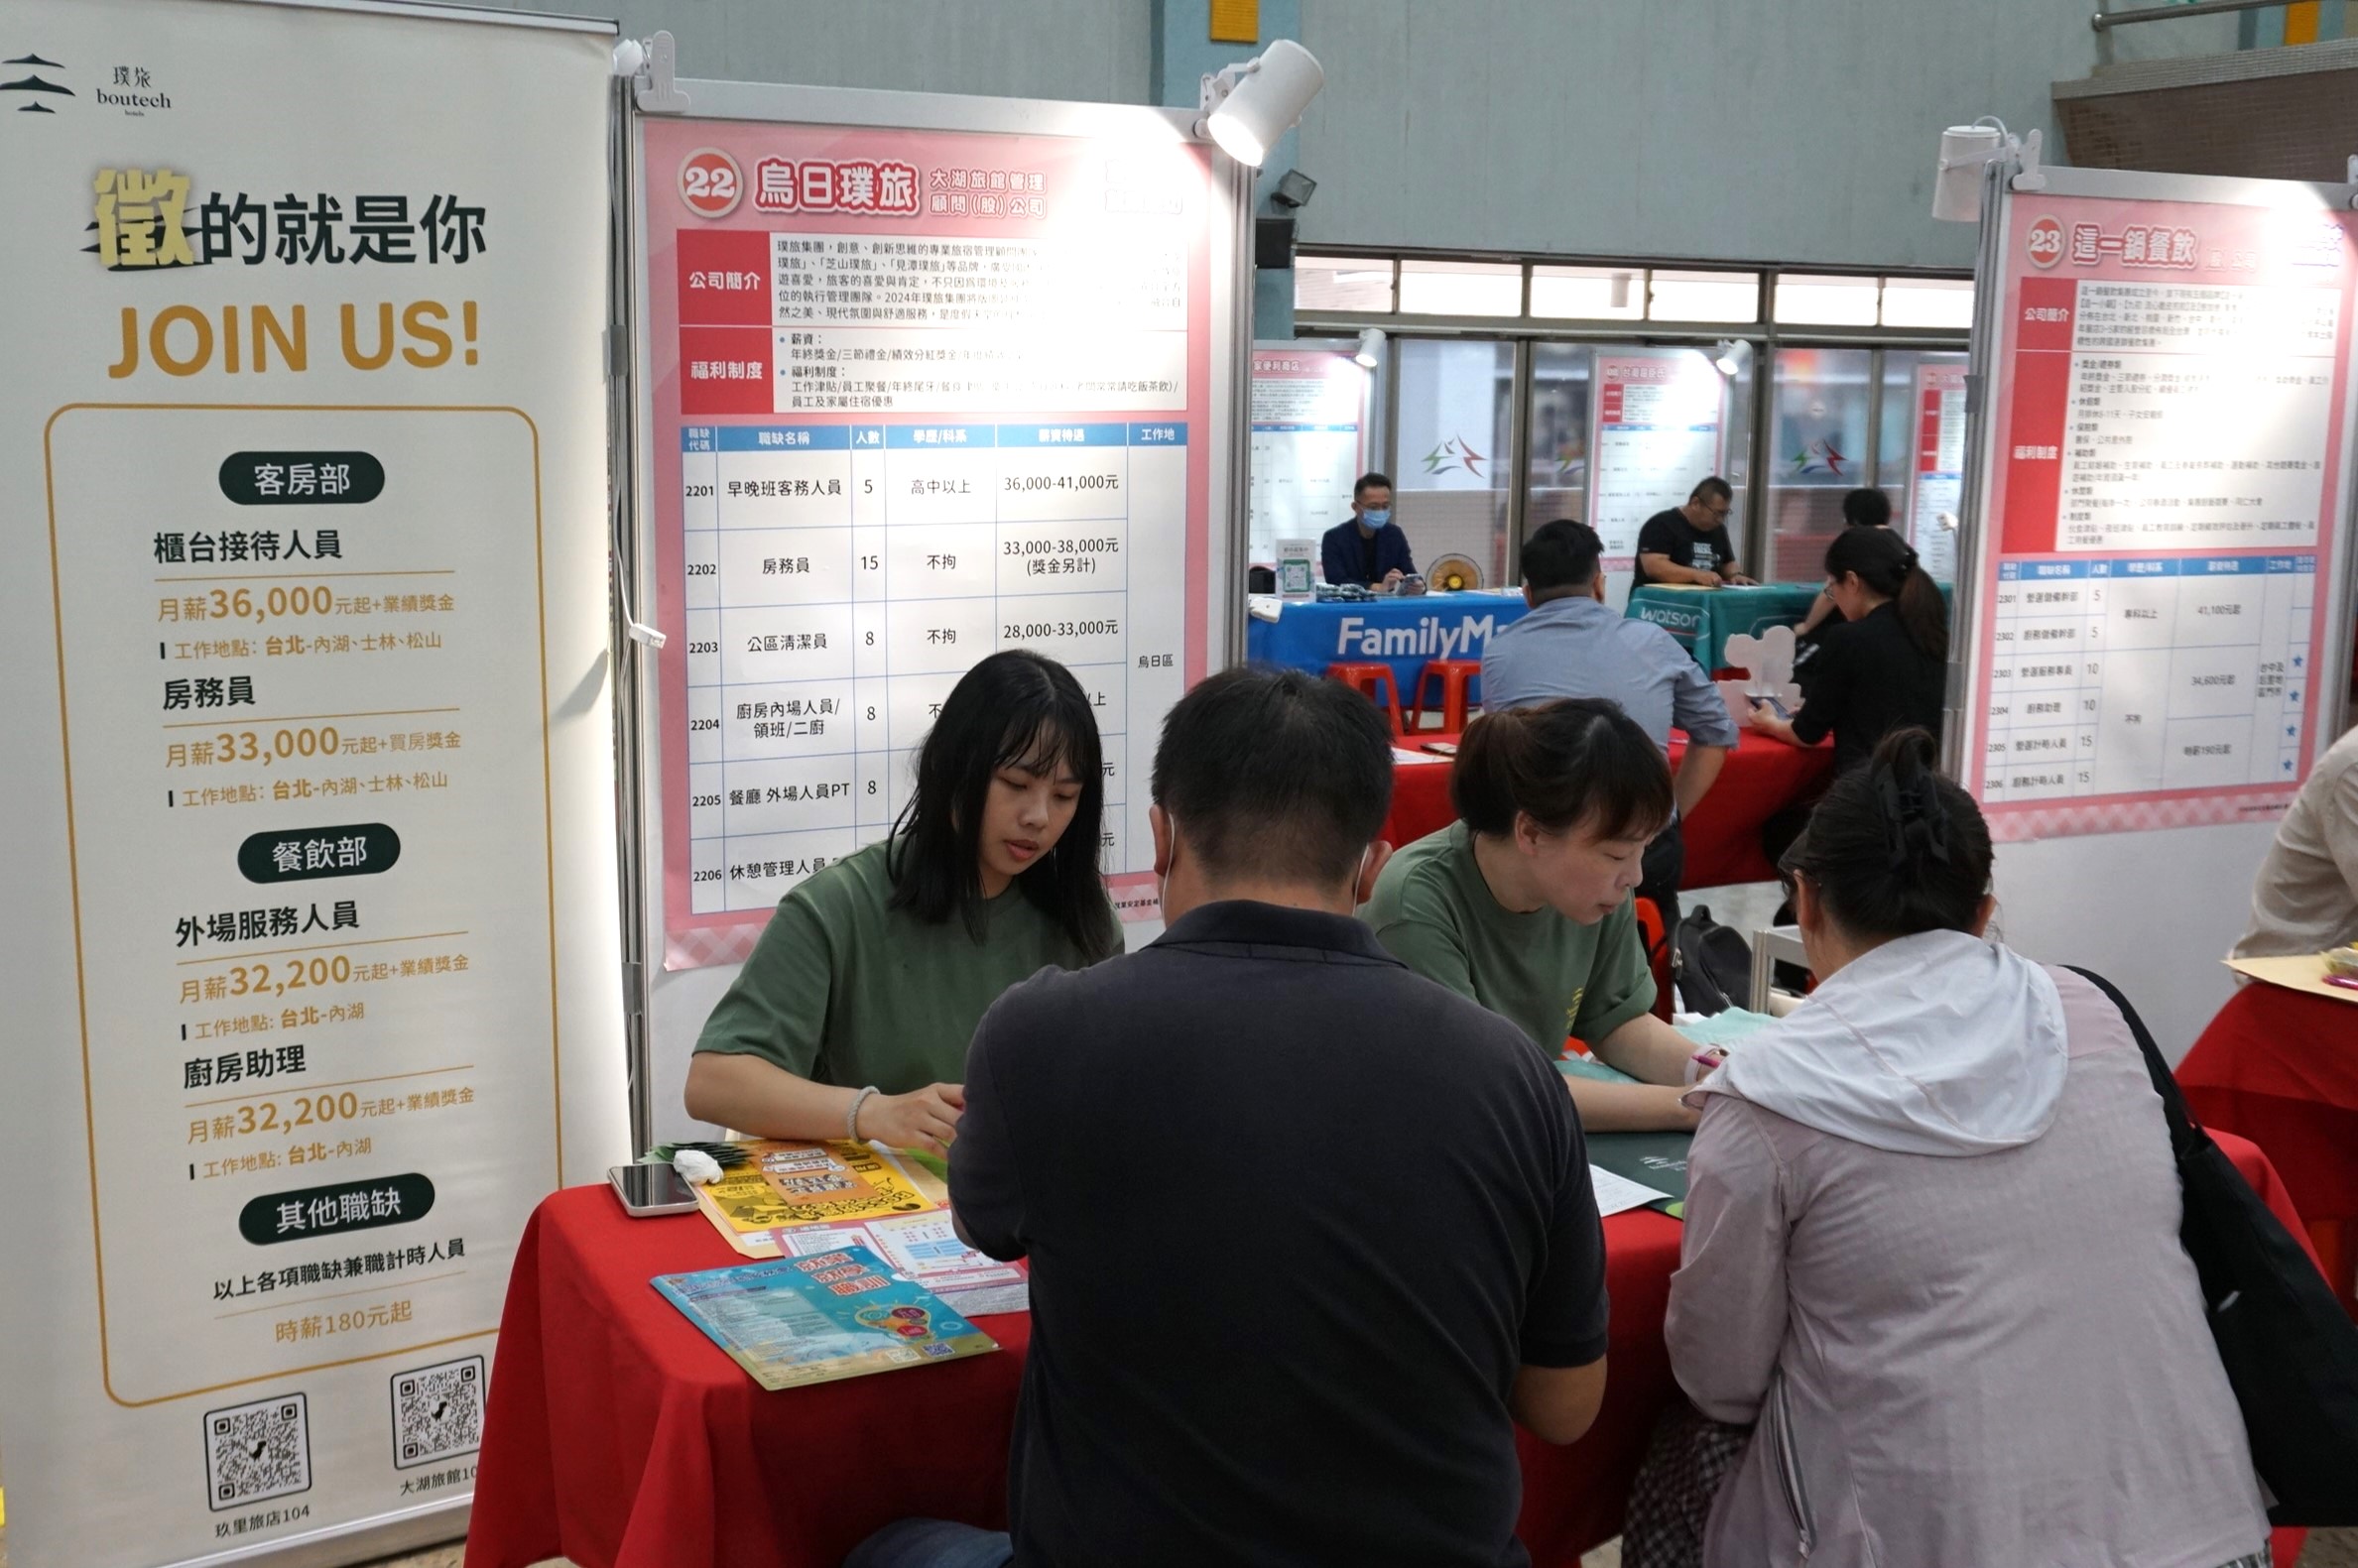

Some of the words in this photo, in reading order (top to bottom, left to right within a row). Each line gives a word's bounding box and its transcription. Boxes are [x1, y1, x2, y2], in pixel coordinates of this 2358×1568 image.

[113, 65, 151, 87] 璞旅
[96, 88, 171, 108] boutech
[684, 165, 737, 198] 22
[759, 164, 917, 210] 烏日璞旅
[931, 169, 1047, 193] 大湖旅館管理
[931, 196, 1047, 217] 顧問(股)公司
[93, 169, 487, 271] 徵的就是你
[2030, 229, 2061, 253] 23
[2074, 226, 2195, 265] 這一鍋餐飲
[688, 271, 762, 291] 公司簡介
[2025, 308, 2069, 321] 公司簡介
[108, 304, 309, 380] JOIN
[340, 301, 478, 370] US!
[691, 361, 762, 380] 福利制度
[792, 395, 893, 408] 員工及家屬住宿優惠
[758, 432, 809, 445] 職缺名稱
[856, 431, 880, 444] 人數
[1141, 428, 1175, 440] 工作地
[2014, 445, 2058, 460] 福利制度
[253, 463, 351, 496] 客房部
[727, 479, 841, 496] 早晚班客務人員
[864, 479, 873, 494] 5
[911, 478, 971, 494] 高中以上
[1004, 474, 1119, 492] 36,000-41,000元
[684, 485, 715, 497] 2201
[153, 529, 343, 564] 櫃台接待人員
[1003, 538, 1119, 555] 33,000-38,000元
[686, 563, 716, 575] 2202
[762, 557, 810, 574] 房務員
[860, 556, 879, 570] 15
[927, 553, 956, 570] 不拘
[1027, 556, 1097, 575] (獎金另計)
[157, 585, 455, 623] 月薪36,000元起+業績獎金
[1999, 594, 2017, 604] 2301
[2094, 590, 2101, 601] 5
[927, 628, 956, 645] 不拘
[1003, 620, 1119, 638] 28,000-33,000元
[1996, 633, 2015, 642] 2302
[2091, 627, 2098, 638] 5
[747, 635, 827, 652] 公區清潔員
[865, 632, 874, 646] 8
[688, 642, 719, 654] 2203
[1138, 654, 1174, 668] 烏日區
[2087, 663, 2099, 674] 10
[162, 674, 256, 711] 房務員
[736, 698, 840, 719] 廚房內場人員/
[867, 706, 876, 721] 8
[2083, 699, 2096, 711] 10
[690, 718, 720, 731] 2204
[754, 720, 824, 739] 領班/二廚
[165, 727, 462, 769] 月薪33,000元起+買房獎金
[2080, 736, 2092, 747] 15
[2077, 773, 2089, 784] 15
[867, 780, 877, 795] 8
[692, 793, 721, 807] 2205
[272, 835, 368, 874] 餐飲部
[693, 869, 722, 882] 2206
[176, 900, 359, 948] 外場服務人員
[180, 954, 469, 1005] 月薪32,200元起+業績獎金
[183, 1044, 308, 1090] 廚房助理
[186, 1085, 475, 1146] 月薪32,200元起+業績獎金
[276, 1187, 402, 1234] 其他職缺
[212, 1238, 466, 1301] 以上各項職缺兼職計時人員
[275, 1300, 413, 1344] 時薪180元起
[214, 1504, 310, 1539] 玖里旅店104
